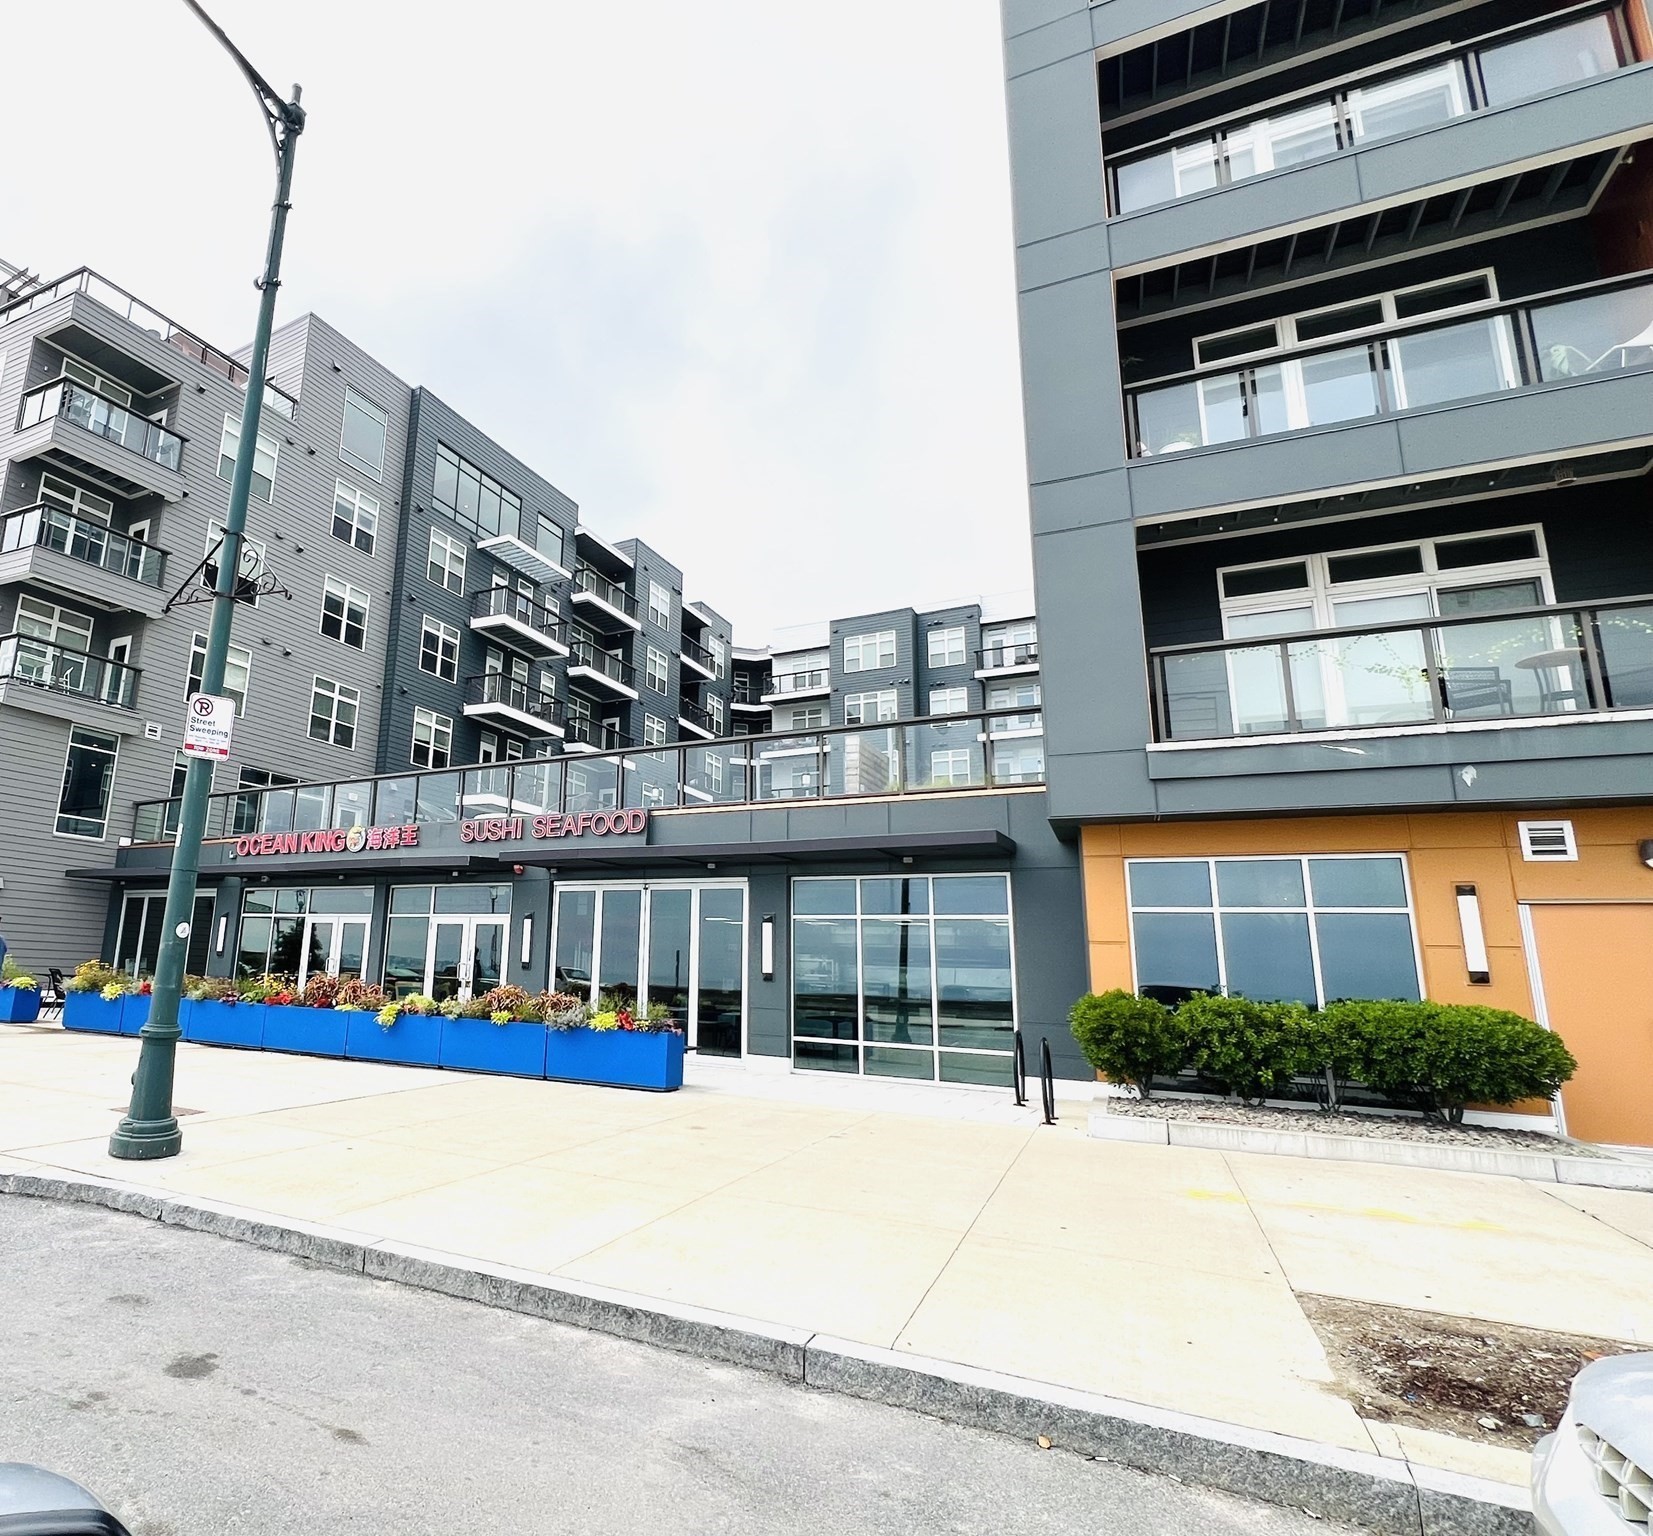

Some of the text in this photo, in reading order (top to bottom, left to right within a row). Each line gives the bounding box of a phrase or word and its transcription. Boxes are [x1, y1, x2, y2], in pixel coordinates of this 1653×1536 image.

[189, 724, 229, 739] Sweeping
[190, 716, 216, 727] Street
[365, 824, 418, 850] 海洋王
[460, 810, 646, 843] SUSHI SEAFOOD
[237, 831, 345, 856] OCEAN KING
